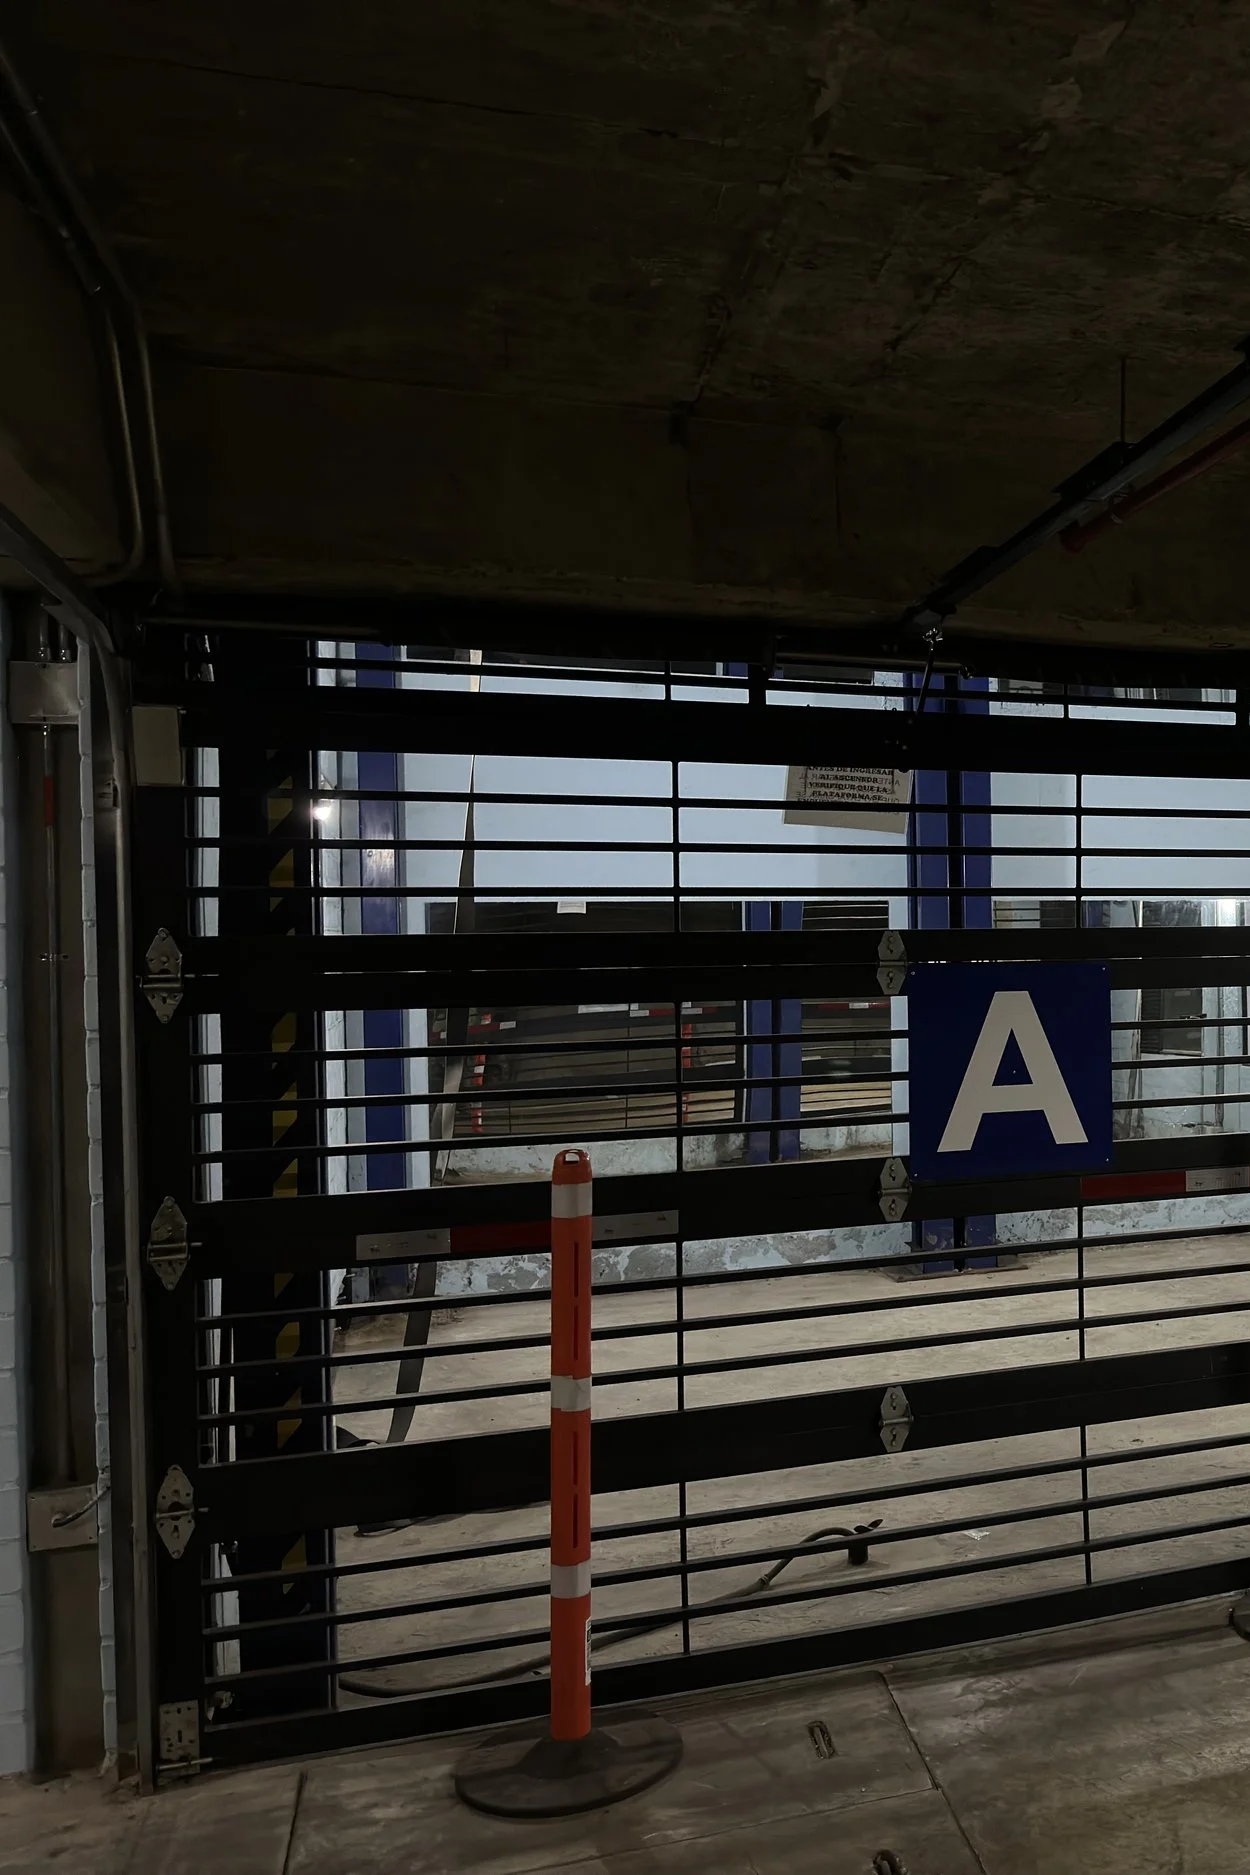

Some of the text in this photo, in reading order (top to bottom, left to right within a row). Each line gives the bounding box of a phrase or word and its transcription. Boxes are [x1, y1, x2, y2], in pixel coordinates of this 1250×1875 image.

[808, 781, 855, 791] VERIFIQUE
[856, 784, 875, 792] QUE
[812, 790, 869, 800] PLATAFORMA
[937, 990, 1089, 1152] A
